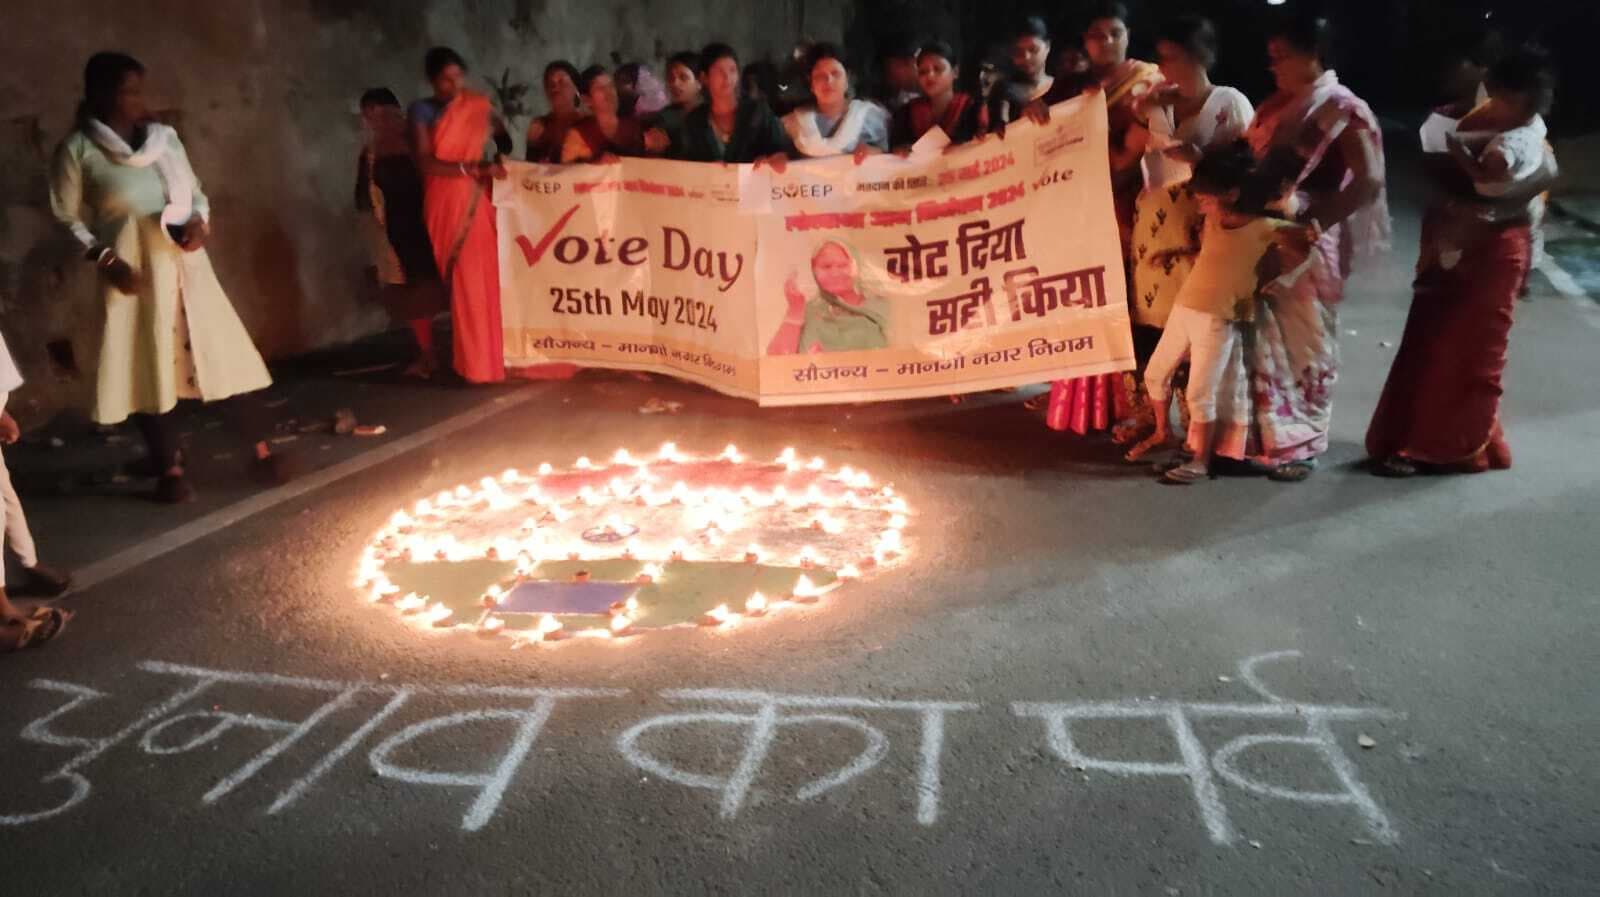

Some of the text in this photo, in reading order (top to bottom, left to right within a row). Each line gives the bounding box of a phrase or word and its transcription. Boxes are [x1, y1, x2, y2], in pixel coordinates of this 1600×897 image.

[771, 182, 833, 201] SWEEP
[662, 226, 744, 292] Day
[884, 216, 1027, 283] वोट दिया
[549, 287, 719, 334] 25th May 2024
[927, 265, 1107, 336] सही किया
[792, 361, 868, 383] सौजन्य
[972, 346, 1021, 368] नगर
[1028, 334, 1095, 360] निगम
[614, 686, 981, 825] का
[1009, 648, 1407, 847] पर्व
